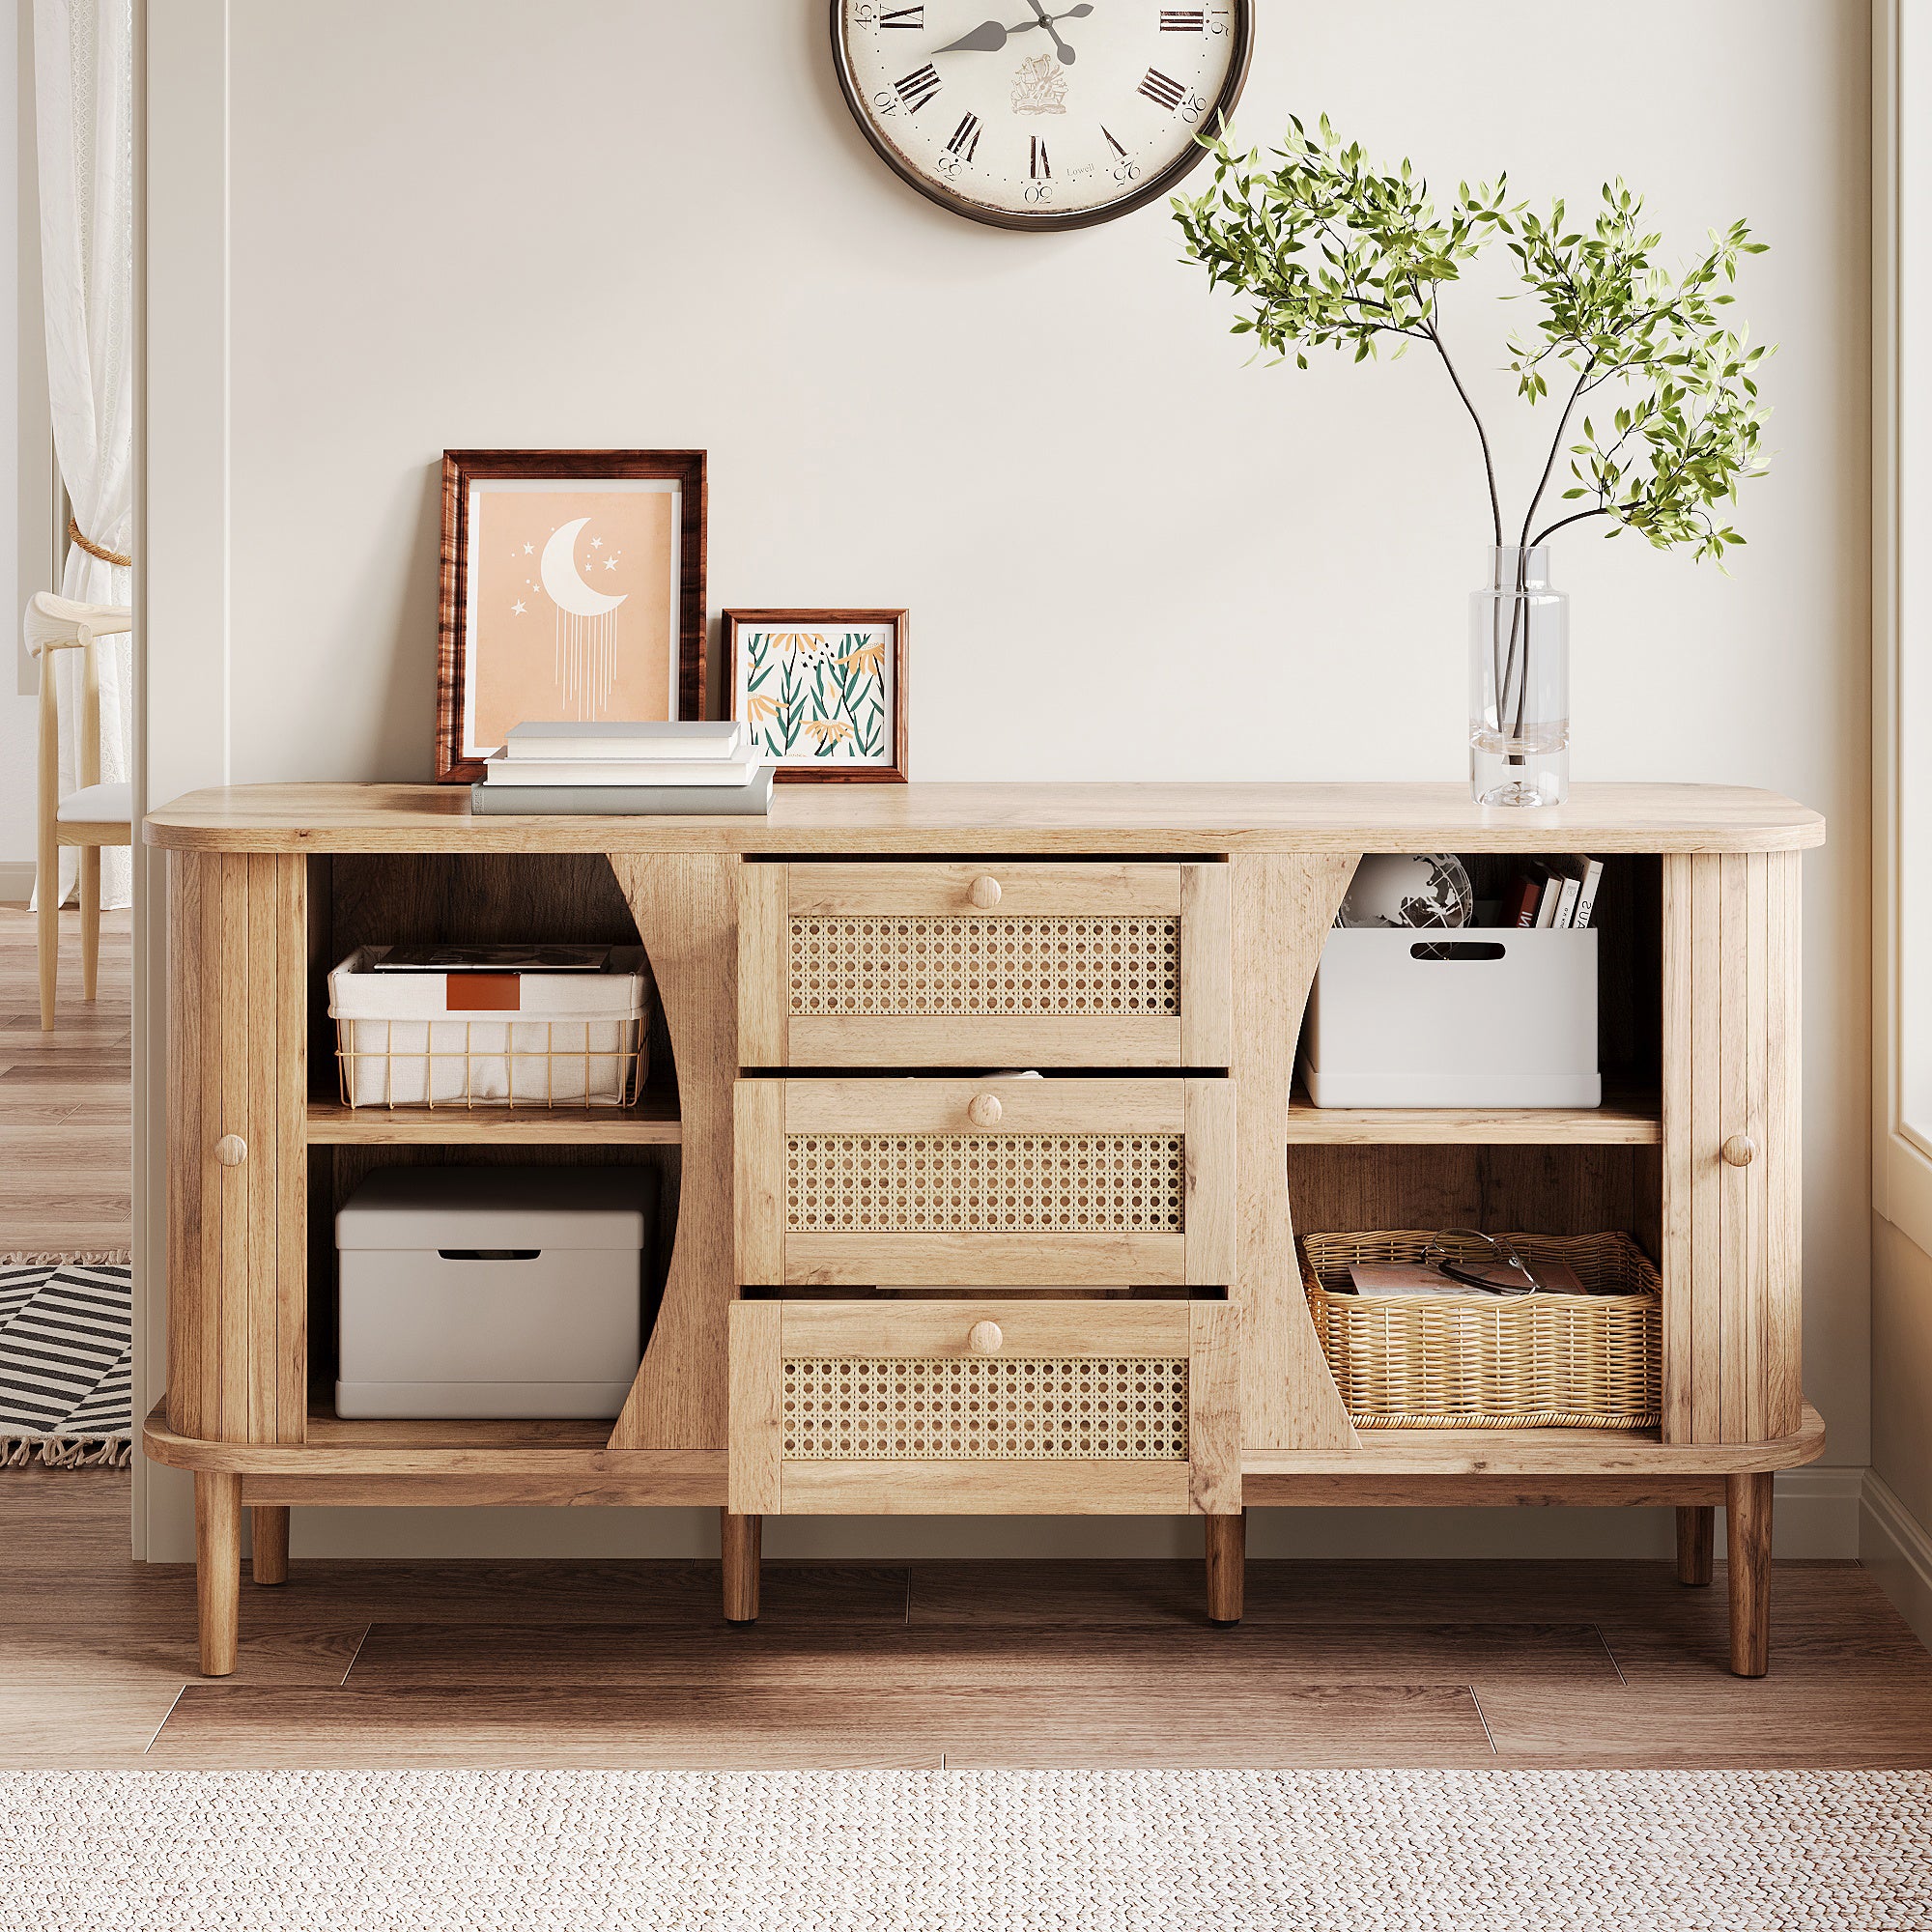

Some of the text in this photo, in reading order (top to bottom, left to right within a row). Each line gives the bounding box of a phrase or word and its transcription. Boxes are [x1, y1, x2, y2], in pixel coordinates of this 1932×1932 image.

[854, 2, 872, 30] 45
[879, 4, 924, 31] IX
[1159, 9, 1204, 33] III
[1211, 10, 1229, 37] 15
[893, 61, 943, 116] VIII
[1135, 66, 1188, 114] IIII
[873, 92, 896, 117] 40
[1181, 94, 1207, 124] 20
[945, 109, 984, 163] VII
[1099, 122, 1129, 162] V
[932, 157, 963, 182] 35
[1029, 135, 1053, 179] VI
[1066, 162, 1095, 177] Lowell
[1113, 159, 1141, 188] 25
[1024, 185, 1053, 205] 30
